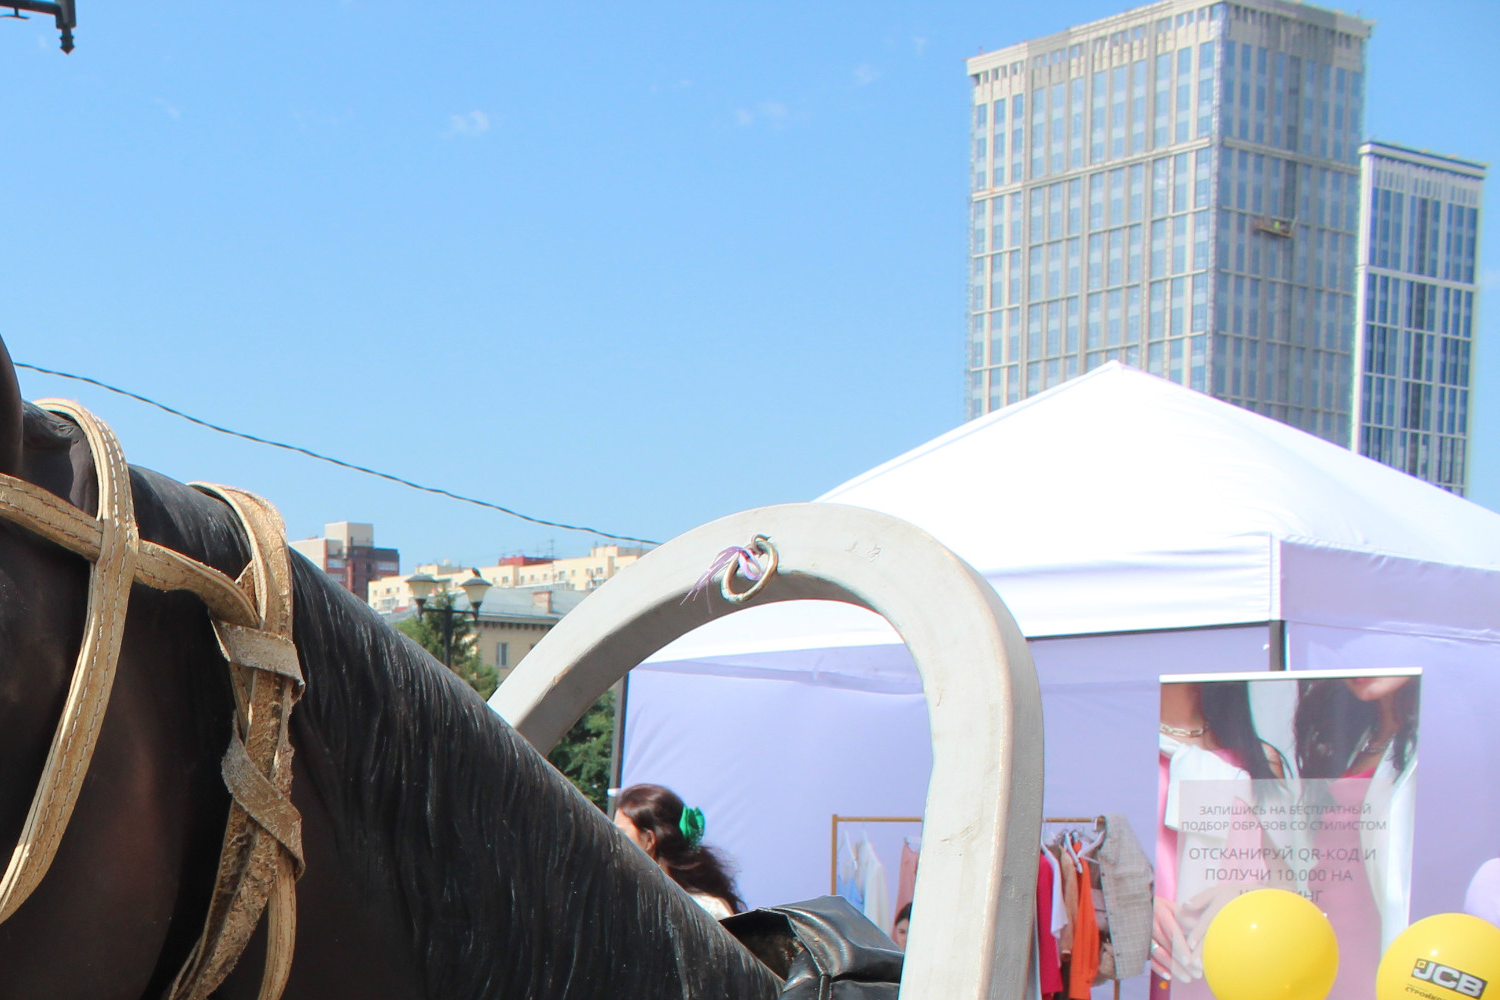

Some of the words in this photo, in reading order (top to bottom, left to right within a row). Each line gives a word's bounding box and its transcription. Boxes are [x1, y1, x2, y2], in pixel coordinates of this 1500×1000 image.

[1199, 805, 1267, 816] ЗАПИШИСЬ
[1269, 805, 1286, 816] НА
[1289, 803, 1372, 816] БЕСПЛАТНЫЙ
[1181, 821, 1230, 832] ПОДБОР
[1232, 821, 1287, 831] ОБРАЗОВ
[1290, 821, 1308, 831] СО
[1309, 821, 1387, 831] СТИЛИСТОМ
[1188, 845, 1294, 861] ОТСКАНИРУЙ
[1297, 847, 1360, 863] QR-КОД
[1365, 848, 1376, 860] И
[1205, 869, 1271, 881] ПОЛУЧИ
[1278, 869, 1327, 882] 10.000
[1331, 870, 1354, 881] НА
[1412, 961, 1484, 998] JCB
